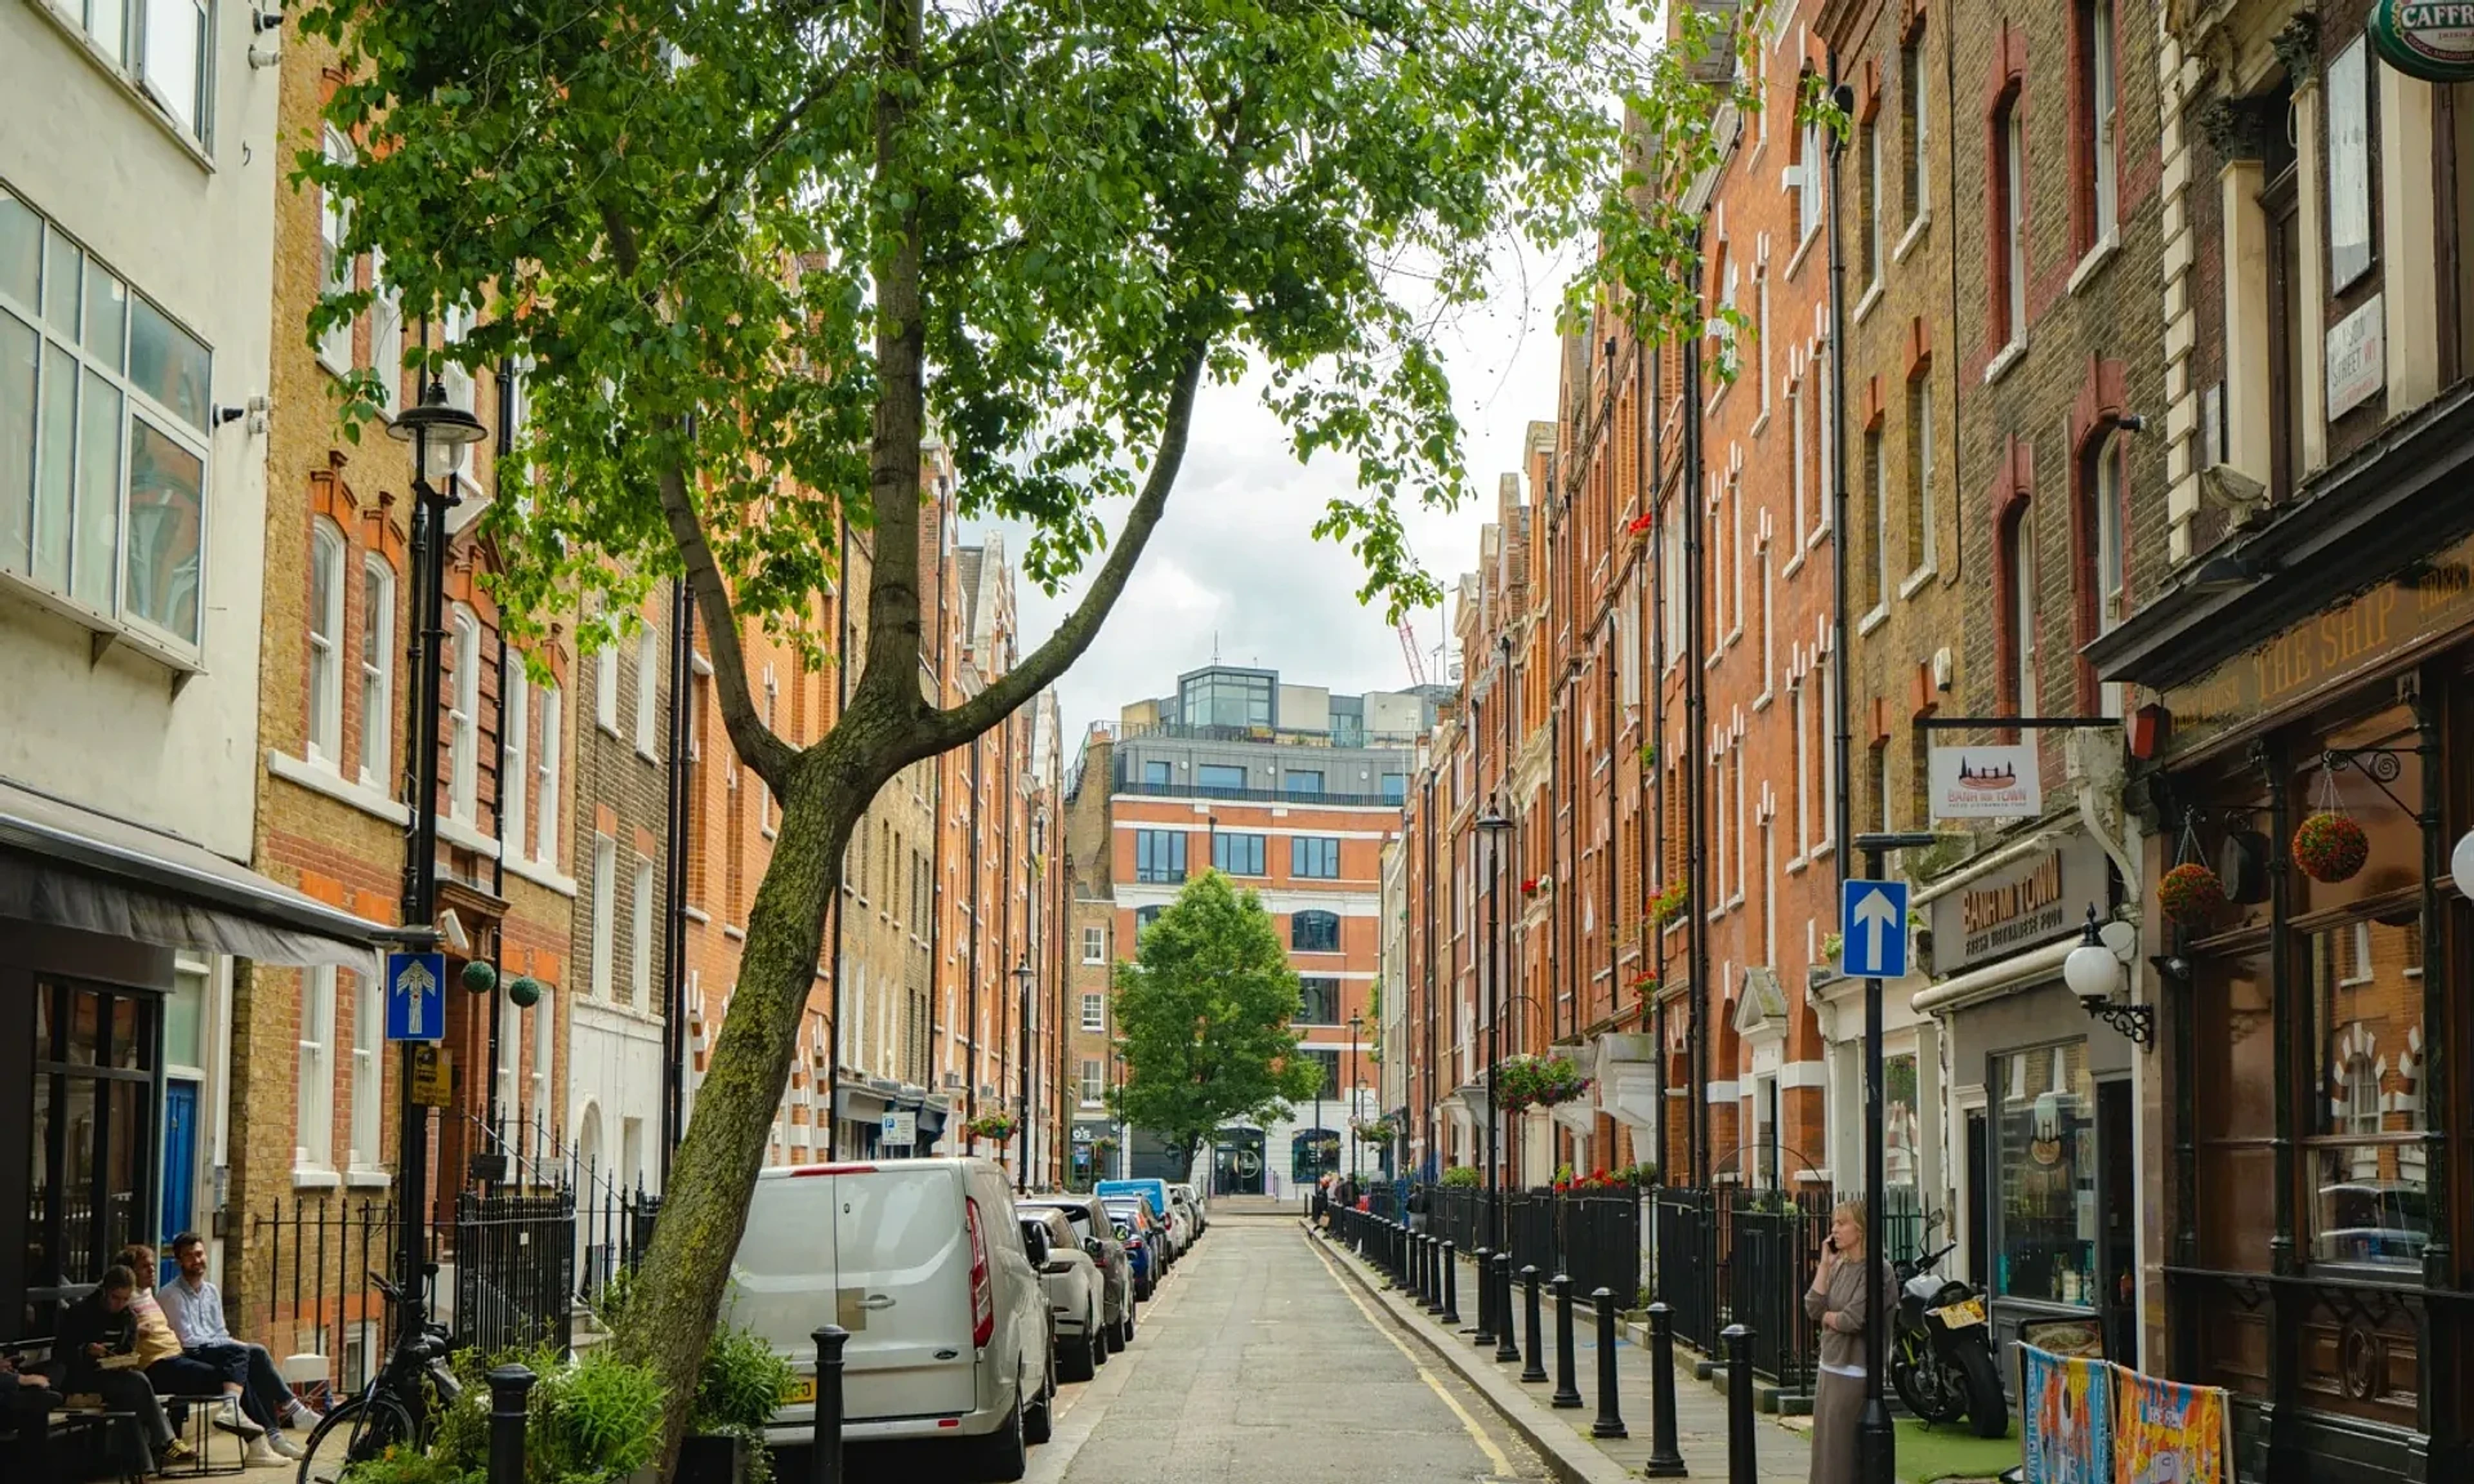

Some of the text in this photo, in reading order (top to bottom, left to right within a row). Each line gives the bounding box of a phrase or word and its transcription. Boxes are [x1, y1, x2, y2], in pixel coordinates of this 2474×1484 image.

[2401, 5, 2474, 28] CAFFR
[2260, 627, 2311, 703] THE
[2321, 581, 2395, 671] SHIP
[1995, 789, 2027, 802] TOWN
[1962, 848, 2062, 935] BANH MI TOWN
